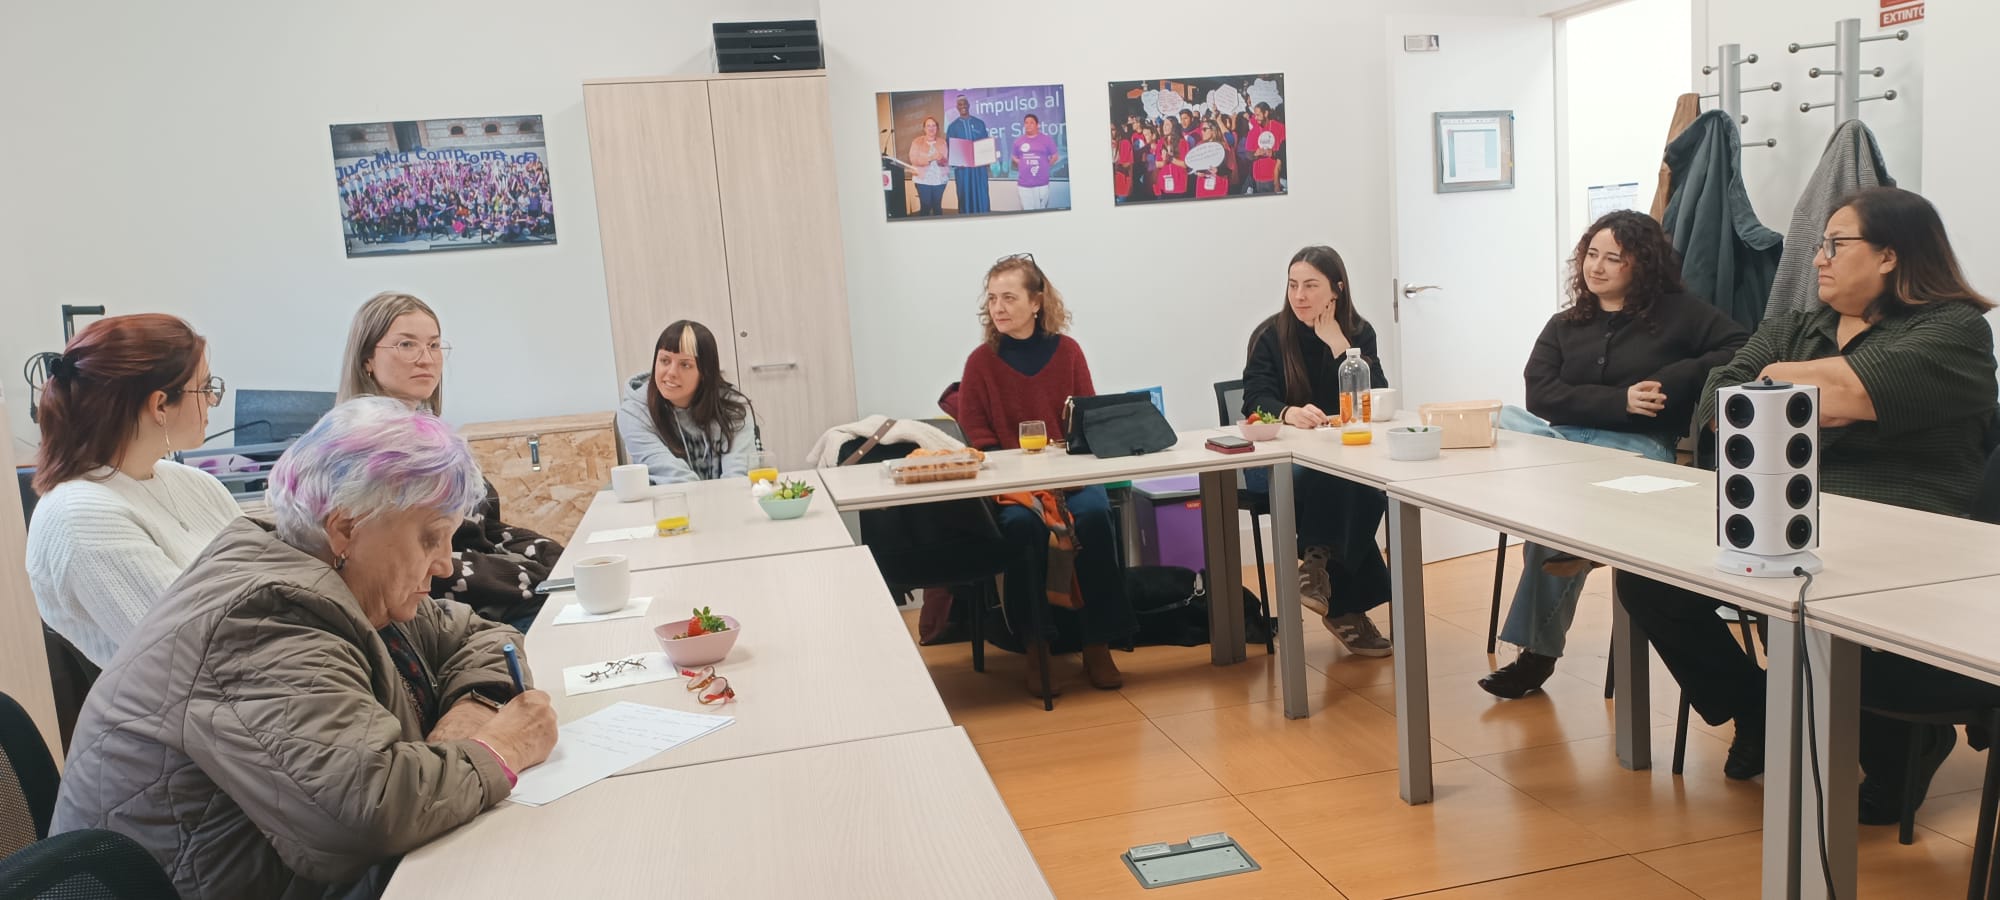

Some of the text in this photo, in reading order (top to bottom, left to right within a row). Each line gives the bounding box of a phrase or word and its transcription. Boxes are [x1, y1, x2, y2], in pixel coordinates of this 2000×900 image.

[976, 91, 1059, 116] impulso al
[1011, 121, 1066, 137] Stor
